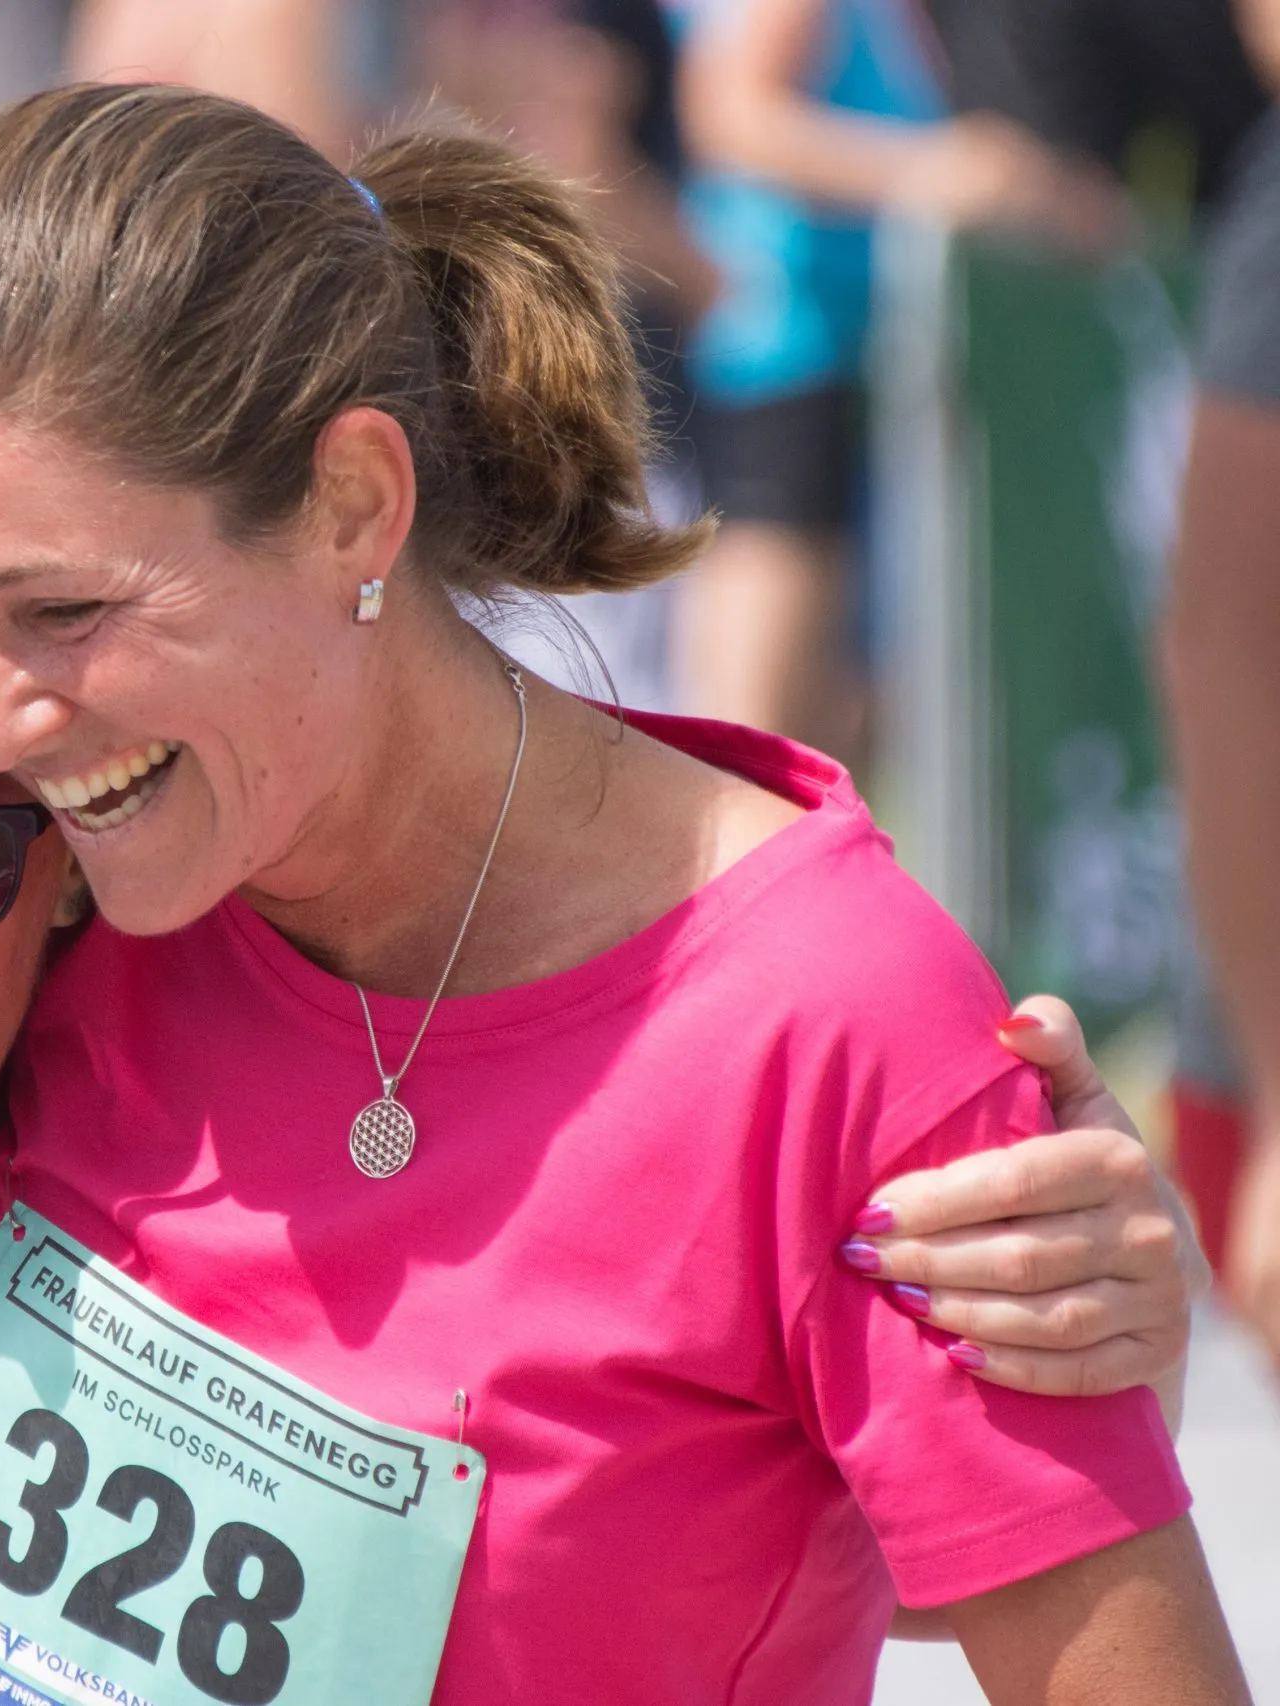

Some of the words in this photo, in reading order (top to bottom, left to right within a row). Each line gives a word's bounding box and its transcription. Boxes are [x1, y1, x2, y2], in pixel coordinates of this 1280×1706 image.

[31, 1266, 199, 1385] FRAUENLAUF
[206, 1376, 397, 1489] GRAFENEGG
[72, 1369, 98, 1401] IM
[104, 1389, 280, 1502] SCHLOSSPARK
[35, 1645, 154, 1706] VOLKSBAN
